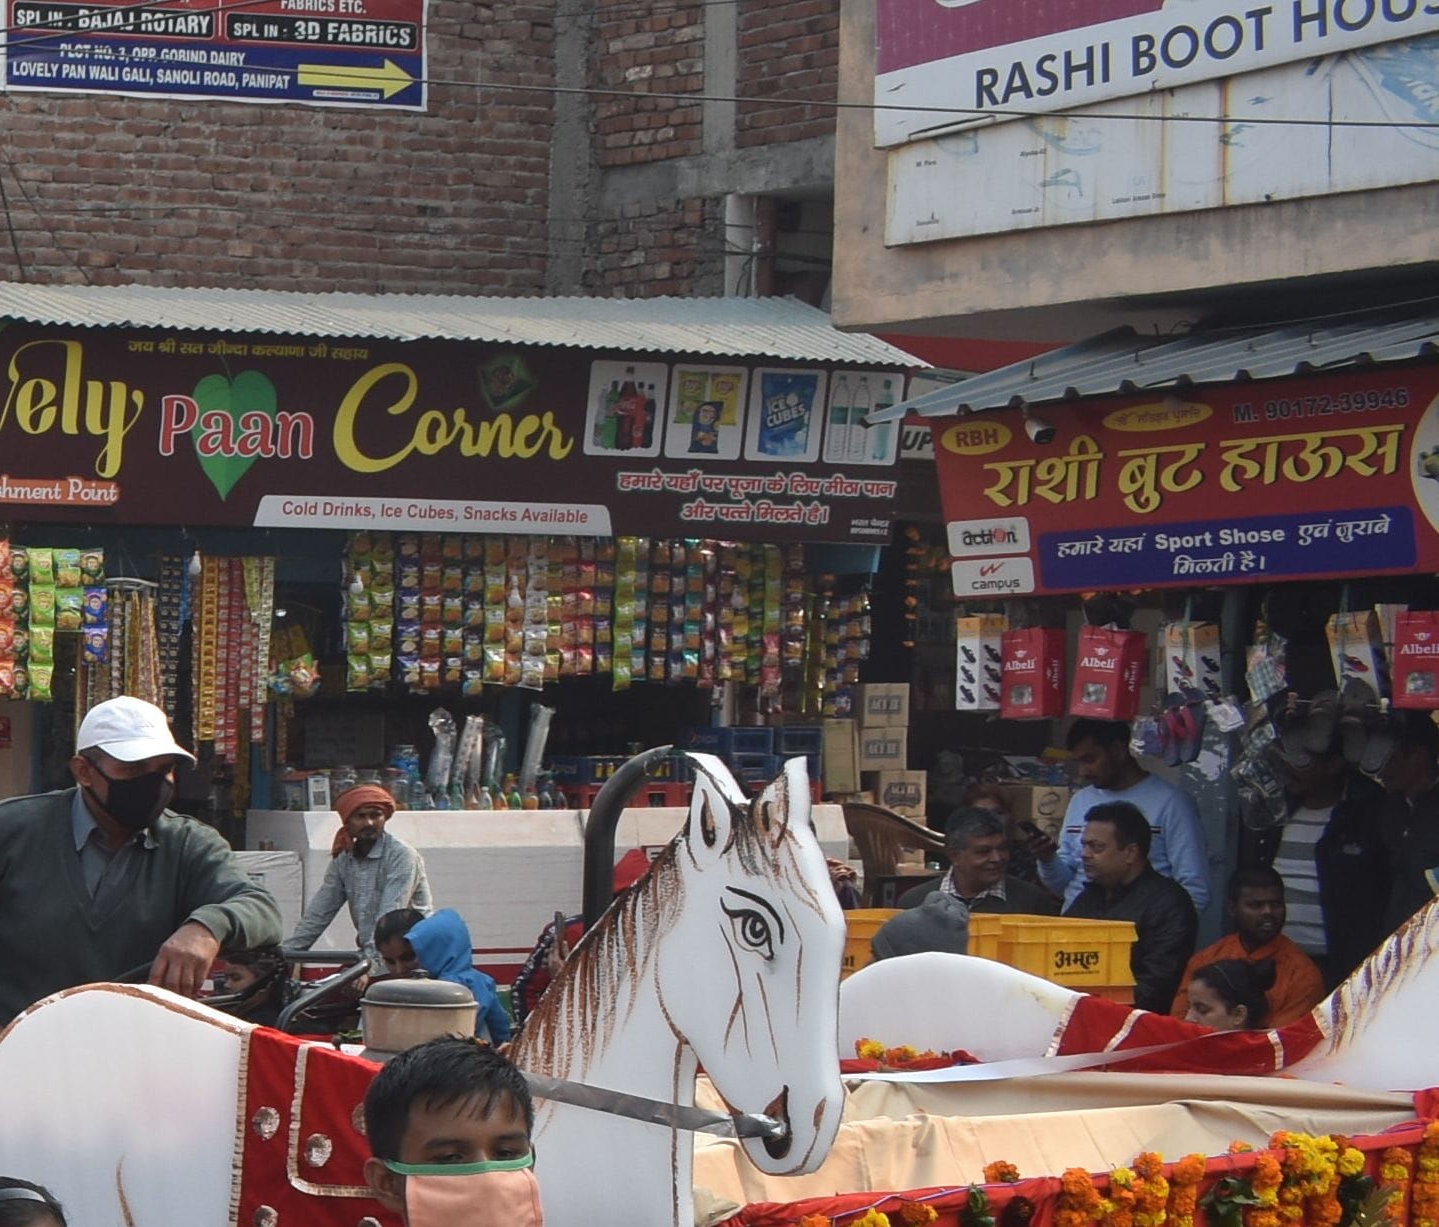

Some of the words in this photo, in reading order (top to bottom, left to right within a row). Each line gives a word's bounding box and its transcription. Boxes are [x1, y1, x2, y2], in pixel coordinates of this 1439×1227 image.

[16, 9, 43, 27] SPL
[141, 12, 210, 36] ROTARY
[233, 22, 262, 38] SPL
[263, 24, 279, 39] IN
[294, 20, 322, 42] 3D
[327, 23, 412, 47] FABRICS
[210, 52, 246, 67] DAIRY
[975, 41, 1113, 108] RASHI
[1131, 6, 1273, 77] BOOT
[12, 61, 59, 78] LOVELY
[61, 64, 86, 80] PAN
[88, 65, 119, 82] WALI
[122, 67, 153, 85] GALI,
[156, 69, 201, 87] SANOLI
[203, 71, 239, 89] ROAD,
[242, 73, 291, 91] PANIPAT
[158, 394, 315, 460] Paan
[332, 362, 574, 474] Corner
[766, 395, 788, 415] ICE
[766, 402, 807, 428] CUBES
[1233, 403, 1259, 424] M.
[1265, 388, 1409, 422] 90172-39946
[955, 427, 1000, 448] RBH
[983, 434, 1104, 508] राशी
[1118, 442, 1207, 514] बुट
[1219, 423, 1406, 493] हाऊस
[66, 477, 119, 503] Point
[618, 468, 662, 491] हमारे
[701, 475, 724, 492] पर
[727, 475, 763, 498] पूजा
[766, 472, 785, 492] के
[788, 473, 822, 495] लिए
[863, 478, 897, 497] पान
[281, 500, 319, 518] Cold
[321, 501, 376, 521] Drinks,
[379, 504, 404, 520] Ice
[407, 505, 460, 524] Cubes,
[463, 506, 518, 524] Snacks
[521, 507, 589, 526] Available
[681, 503, 719, 521] और
[753, 502, 804, 523] मिलते
[1057, 535, 1104, 560] हमारे
[1107, 530, 1145, 556] यहां
[1154, 529, 1214, 552] Sport
[1218, 525, 1286, 548] Shose
[1297, 516, 1335, 546] एवं
[1172, 553, 1236, 577] मिलती
[1239, 550, 1267, 573] है।
[971, 575, 1022, 592] campus
[1003, 658, 1037, 673] Albeli
[1079, 655, 1116, 670] Albeli
